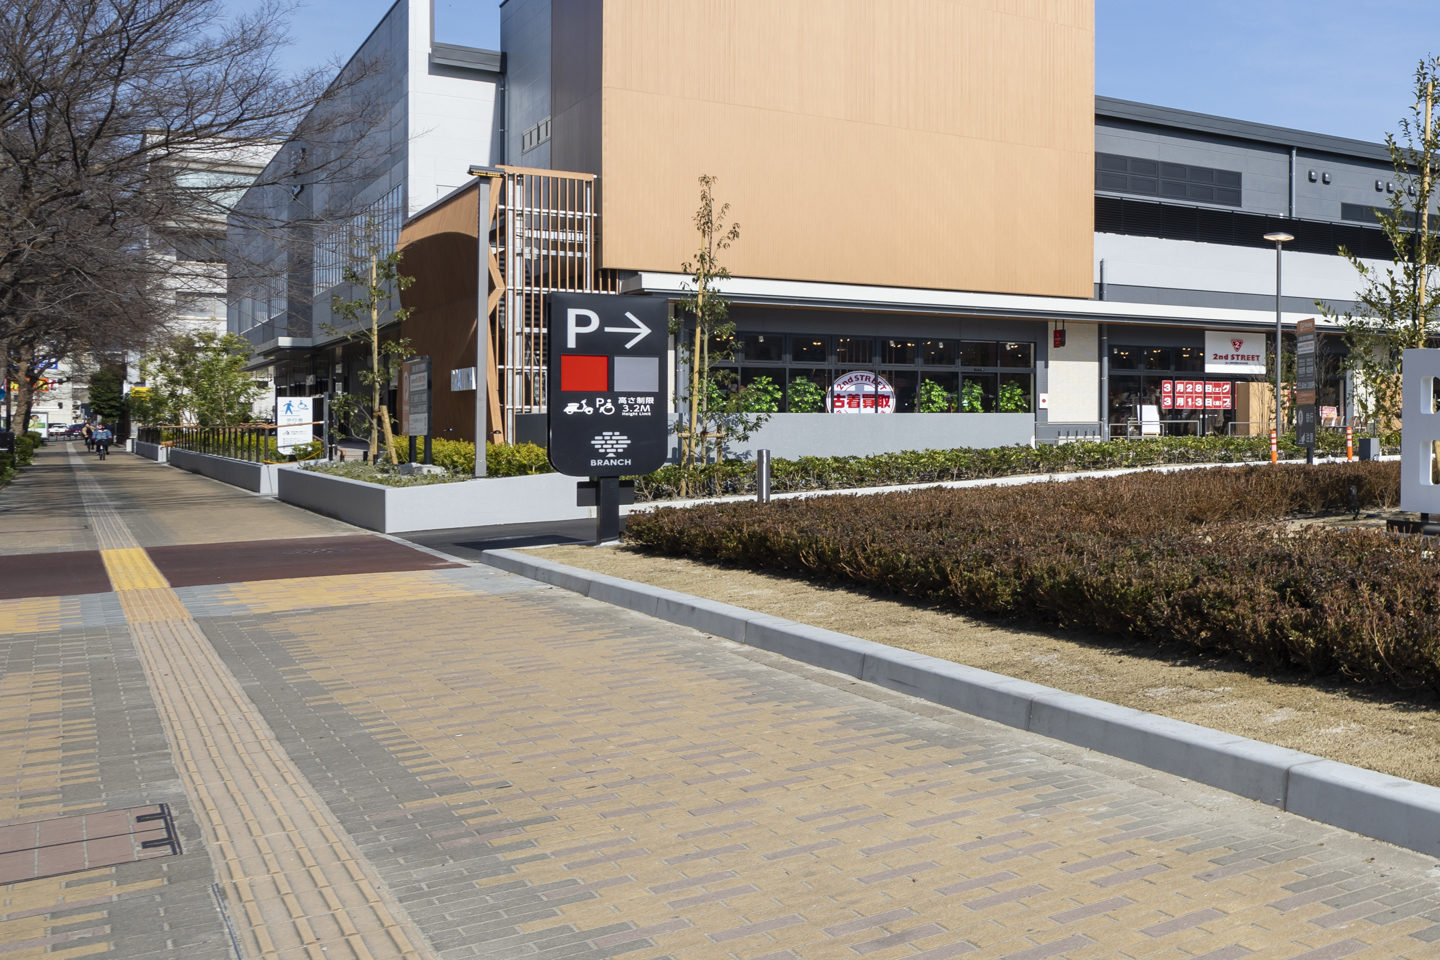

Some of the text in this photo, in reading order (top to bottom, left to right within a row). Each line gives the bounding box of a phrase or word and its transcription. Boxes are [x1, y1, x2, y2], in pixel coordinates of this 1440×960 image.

[566, 308, 600, 349] P
[1231, 354, 1260, 362] STREET
[837, 374, 887, 390] 2nd STREET
[596, 398, 604, 408] P
[834, 393, 890, 409] 古着買取
[622, 404, 651, 412] 3.2M
[590, 458, 632, 466] BRANCH
